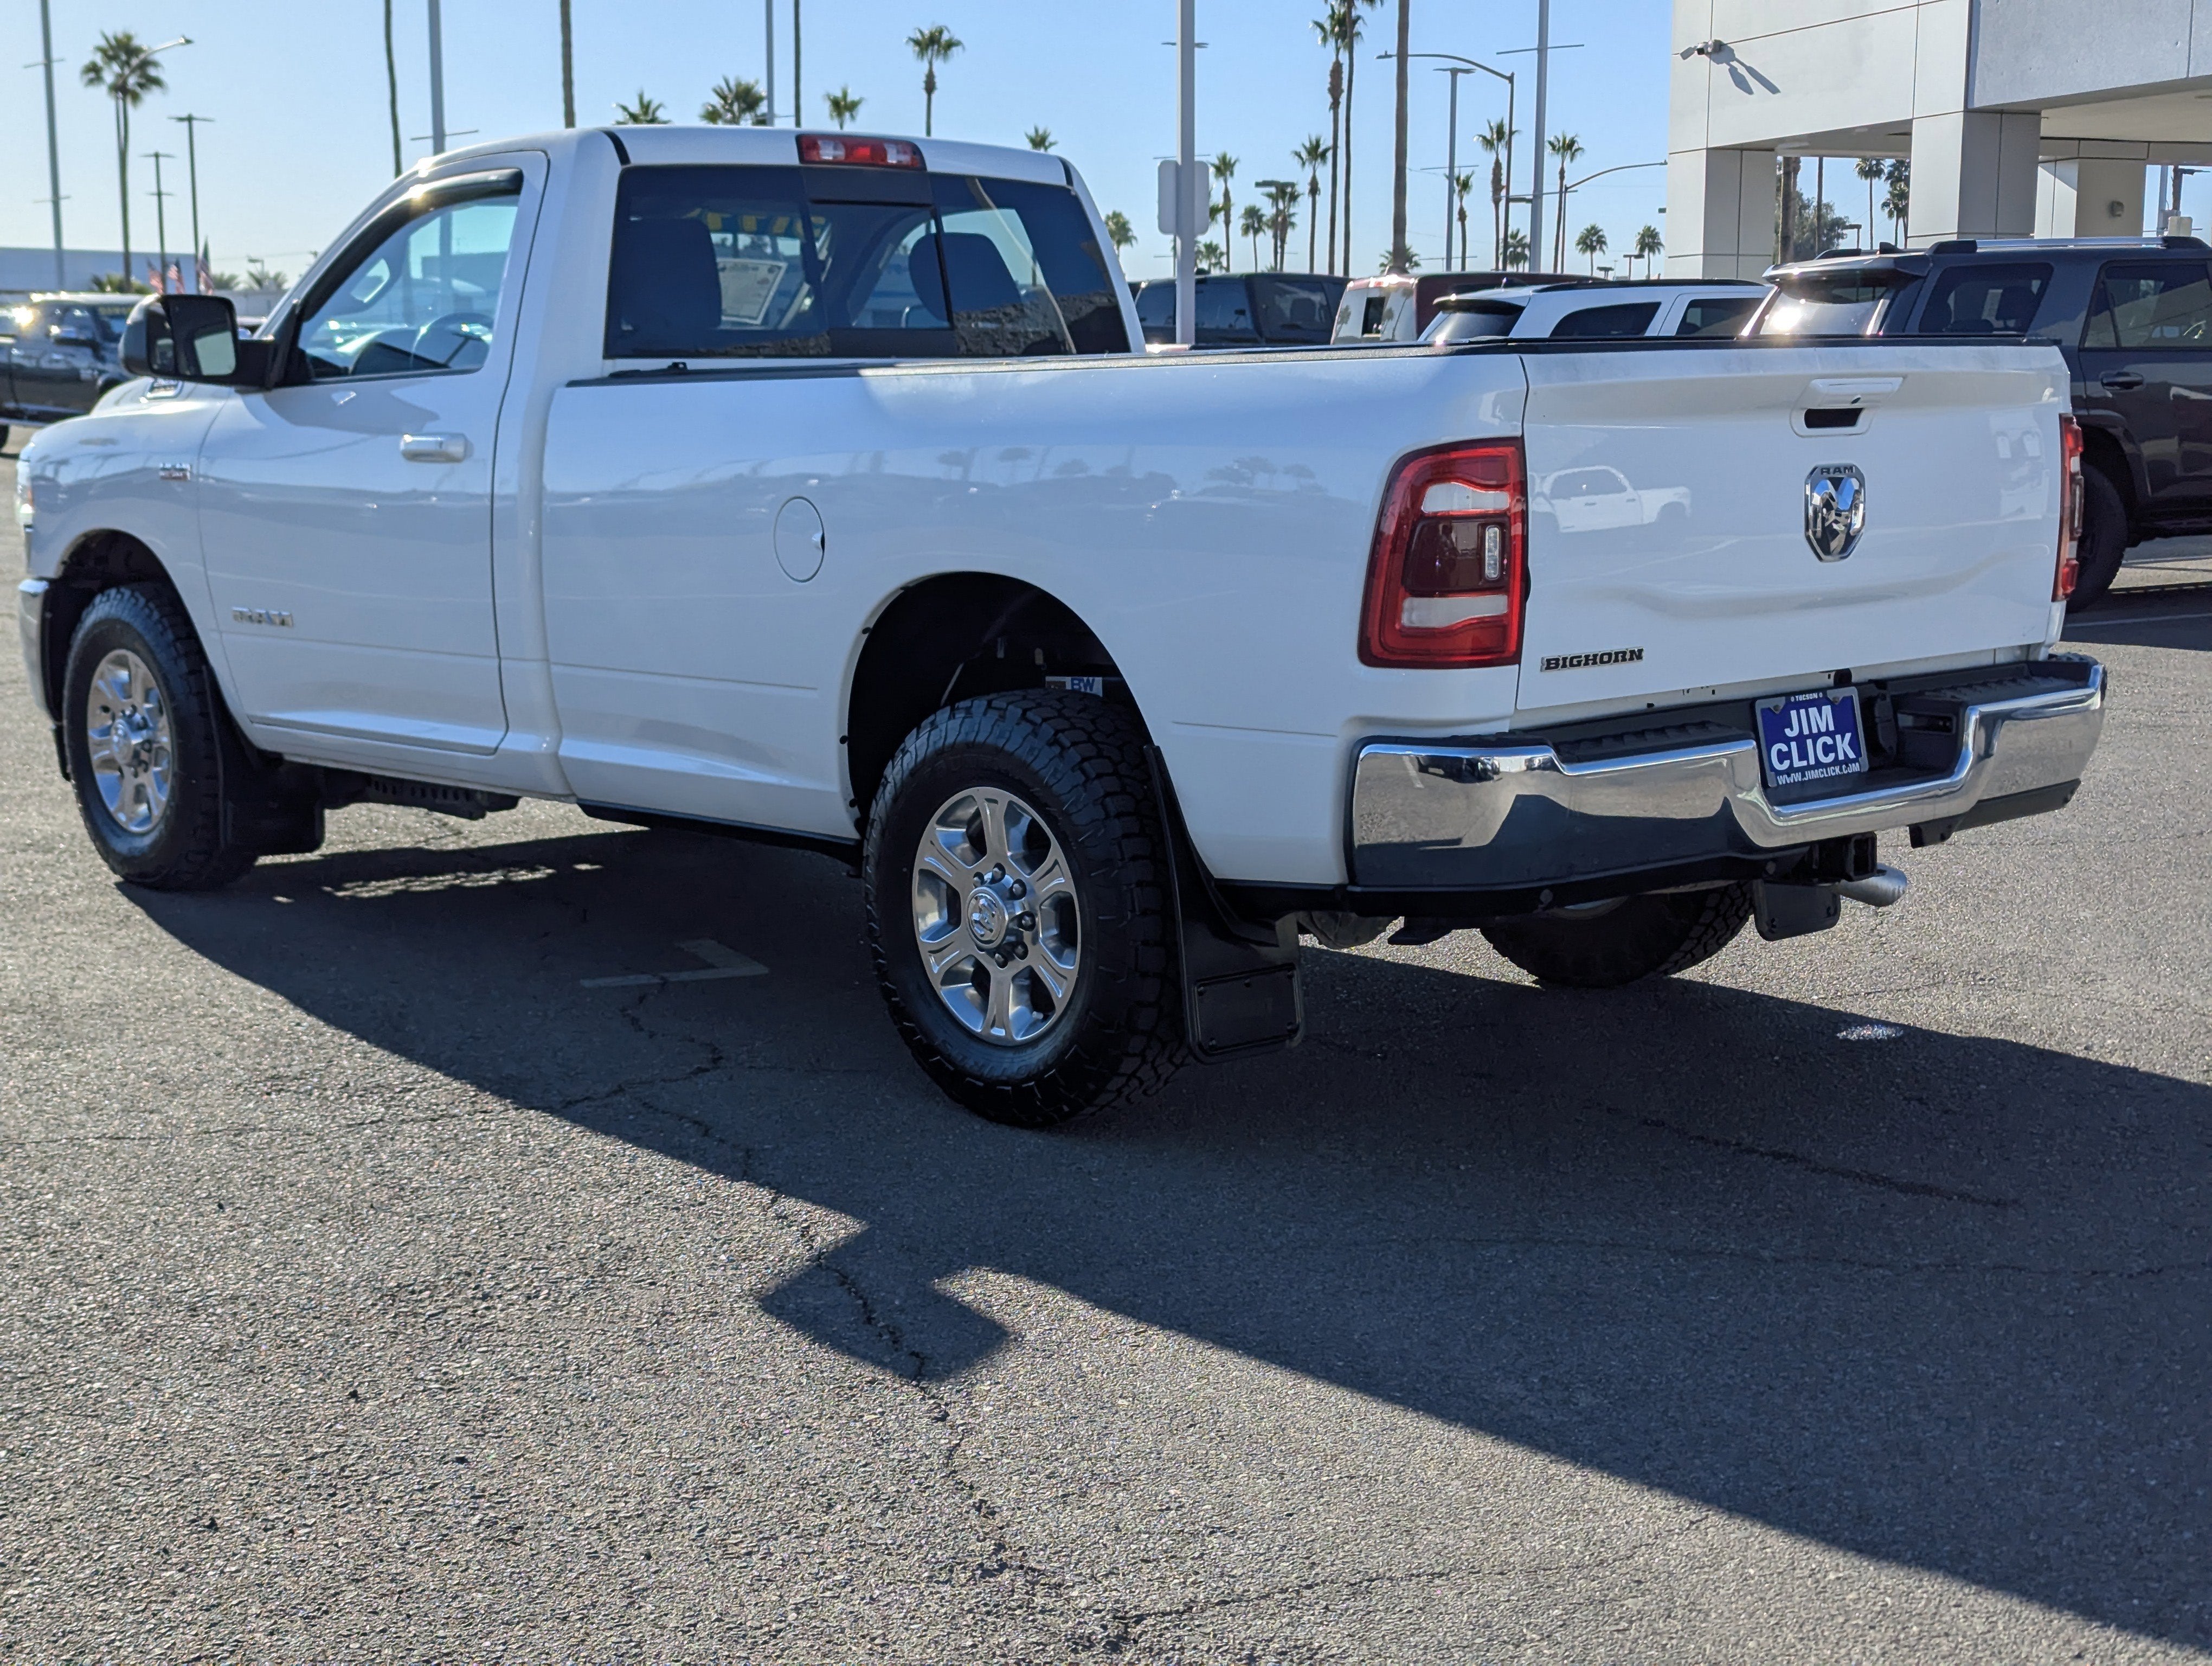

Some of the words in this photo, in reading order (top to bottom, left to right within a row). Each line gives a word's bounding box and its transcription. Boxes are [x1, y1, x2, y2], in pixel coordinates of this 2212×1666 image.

[1820, 465, 1855, 476] RAM
[1544, 648, 1644, 670] BIGHORN
[1796, 693, 1818, 701] TUCSON
[1784, 704, 1835, 737] JIM
[1771, 732, 1856, 771] CLICK
[1777, 762, 1860, 785] WWW.JIMCLICK.COM
